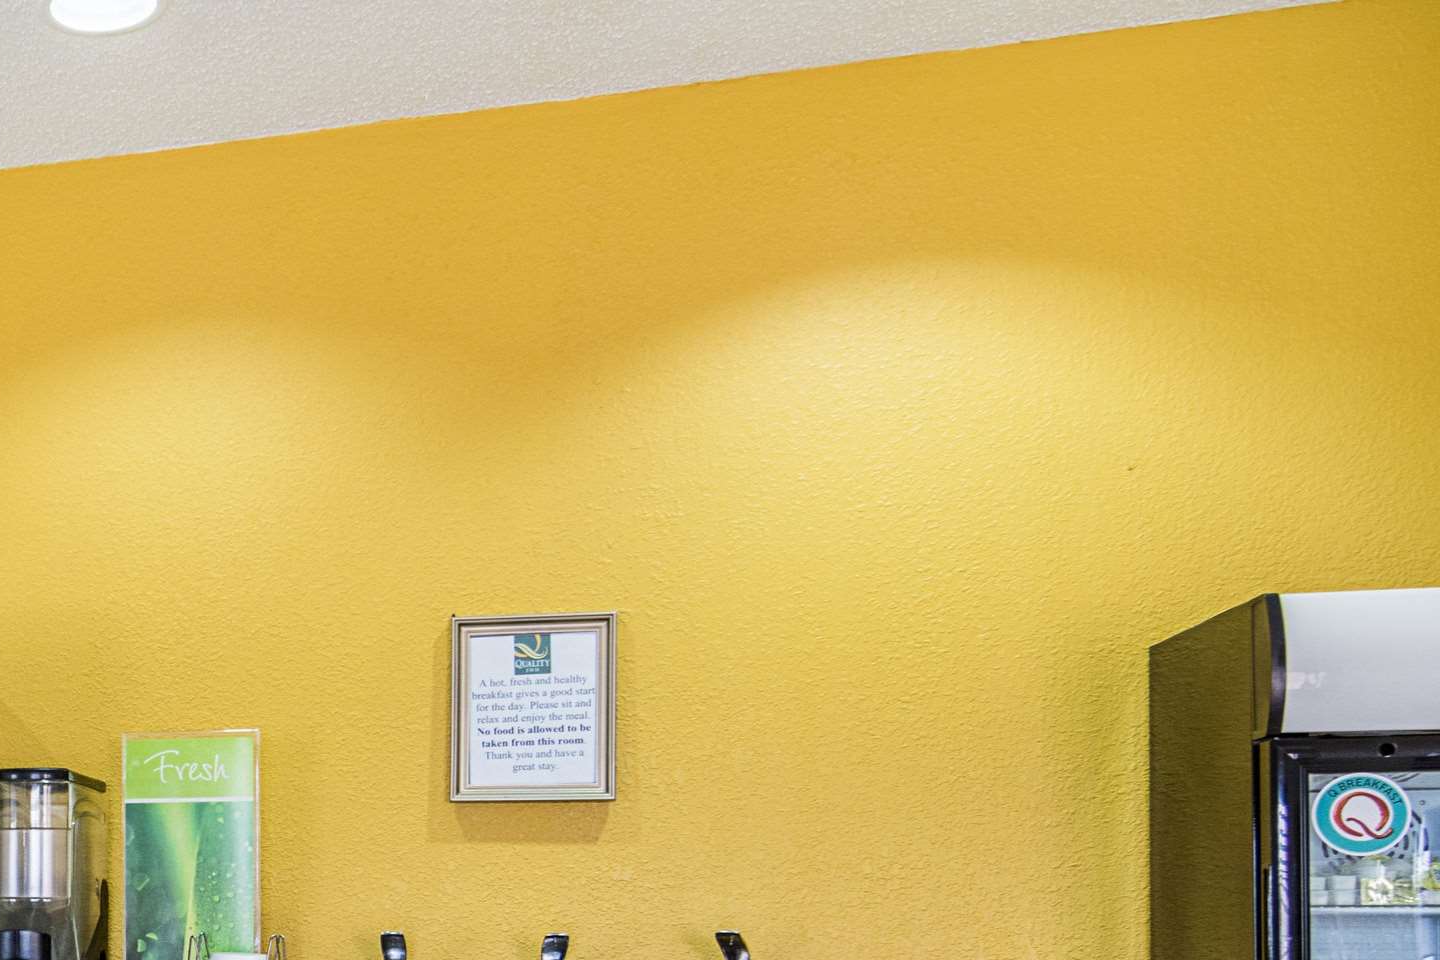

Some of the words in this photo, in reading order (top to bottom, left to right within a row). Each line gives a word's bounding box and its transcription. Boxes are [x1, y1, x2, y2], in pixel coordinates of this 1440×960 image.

[515, 659, 550, 669] QUALITY
[510, 678, 532, 687] fresh
[535, 676, 551, 685] and
[554, 675, 587, 685] healthy
[471, 690, 513, 700] breakfast
[515, 690, 539, 699] gives
[550, 688, 573, 698] good
[575, 687, 596, 695] start
[476, 702, 489, 712] for
[491, 702, 505, 711] the
[530, 701, 558, 710] Please
[561, 700, 572, 708] sit
[575, 699, 591, 708] and
[477, 715, 499, 724] relax
[502, 715, 518, 723] and
[521, 714, 545, 724] enjoy
[549, 712, 562, 721] the
[478, 727, 491, 736] No
[493, 726, 514, 735] food
[517, 726, 525, 734] is
[527, 725, 565, 734] allowed
[567, 725, 577, 733] to
[580, 724, 592, 732] be
[482, 740, 508, 748] taken
[511, 738, 535, 747] from
[537, 737, 555, 746] this
[485, 751, 513, 760] Thank
[516, 752, 533, 761] you
[535, 750, 552, 758] and
[554, 749, 576, 758] have
[144, 749, 230, 785] Fresh
[512, 764, 535, 774] great
[1339, 777, 1404, 805] BREAKFAST
